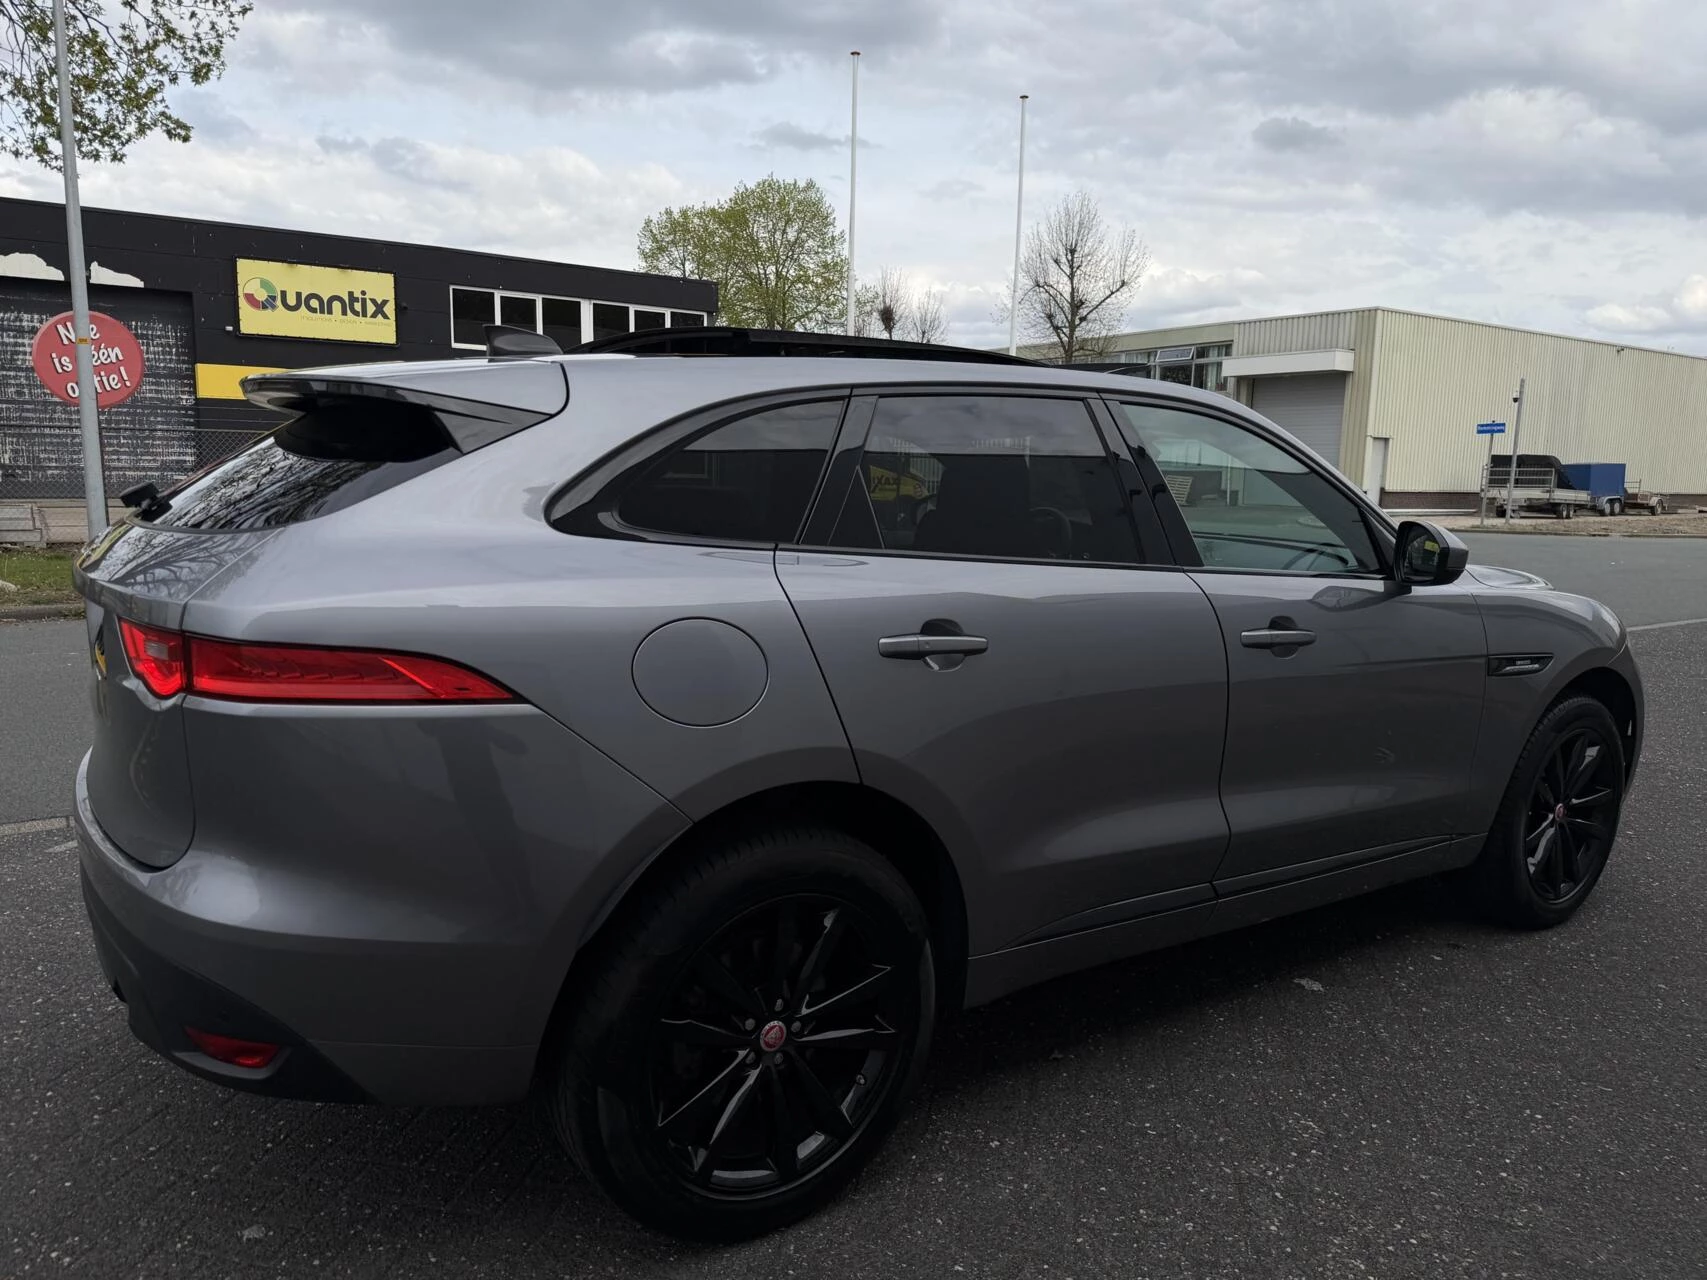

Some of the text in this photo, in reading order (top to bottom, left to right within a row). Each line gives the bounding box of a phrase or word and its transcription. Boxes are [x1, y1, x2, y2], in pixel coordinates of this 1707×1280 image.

[243, 276, 391, 320] Quantix
[56, 321, 100, 345] Ne
[51, 352, 73, 373] is
[66, 366, 131, 398] otie!
